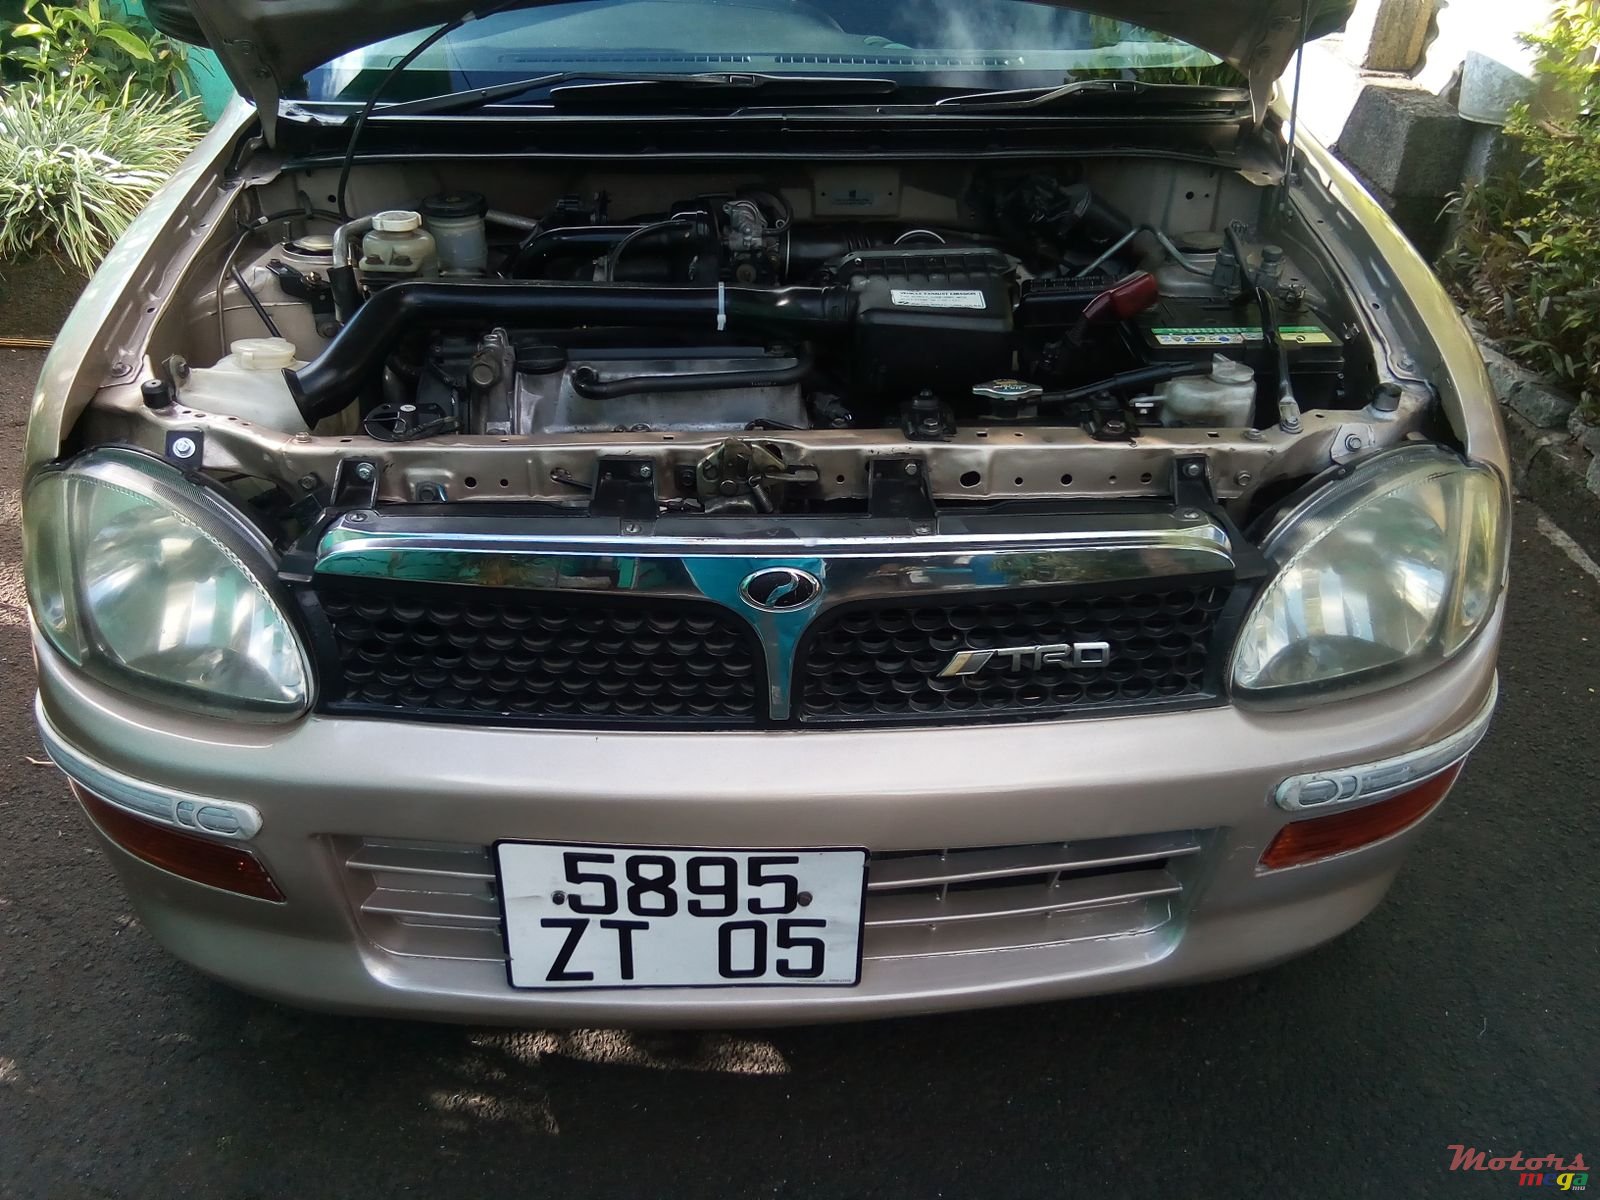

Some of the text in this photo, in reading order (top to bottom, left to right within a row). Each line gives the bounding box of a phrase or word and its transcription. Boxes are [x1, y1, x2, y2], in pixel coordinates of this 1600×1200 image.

[997, 642, 1110, 672] TRD
[563, 852, 800, 917] 5895
[540, 918, 827, 981] ZT 05
